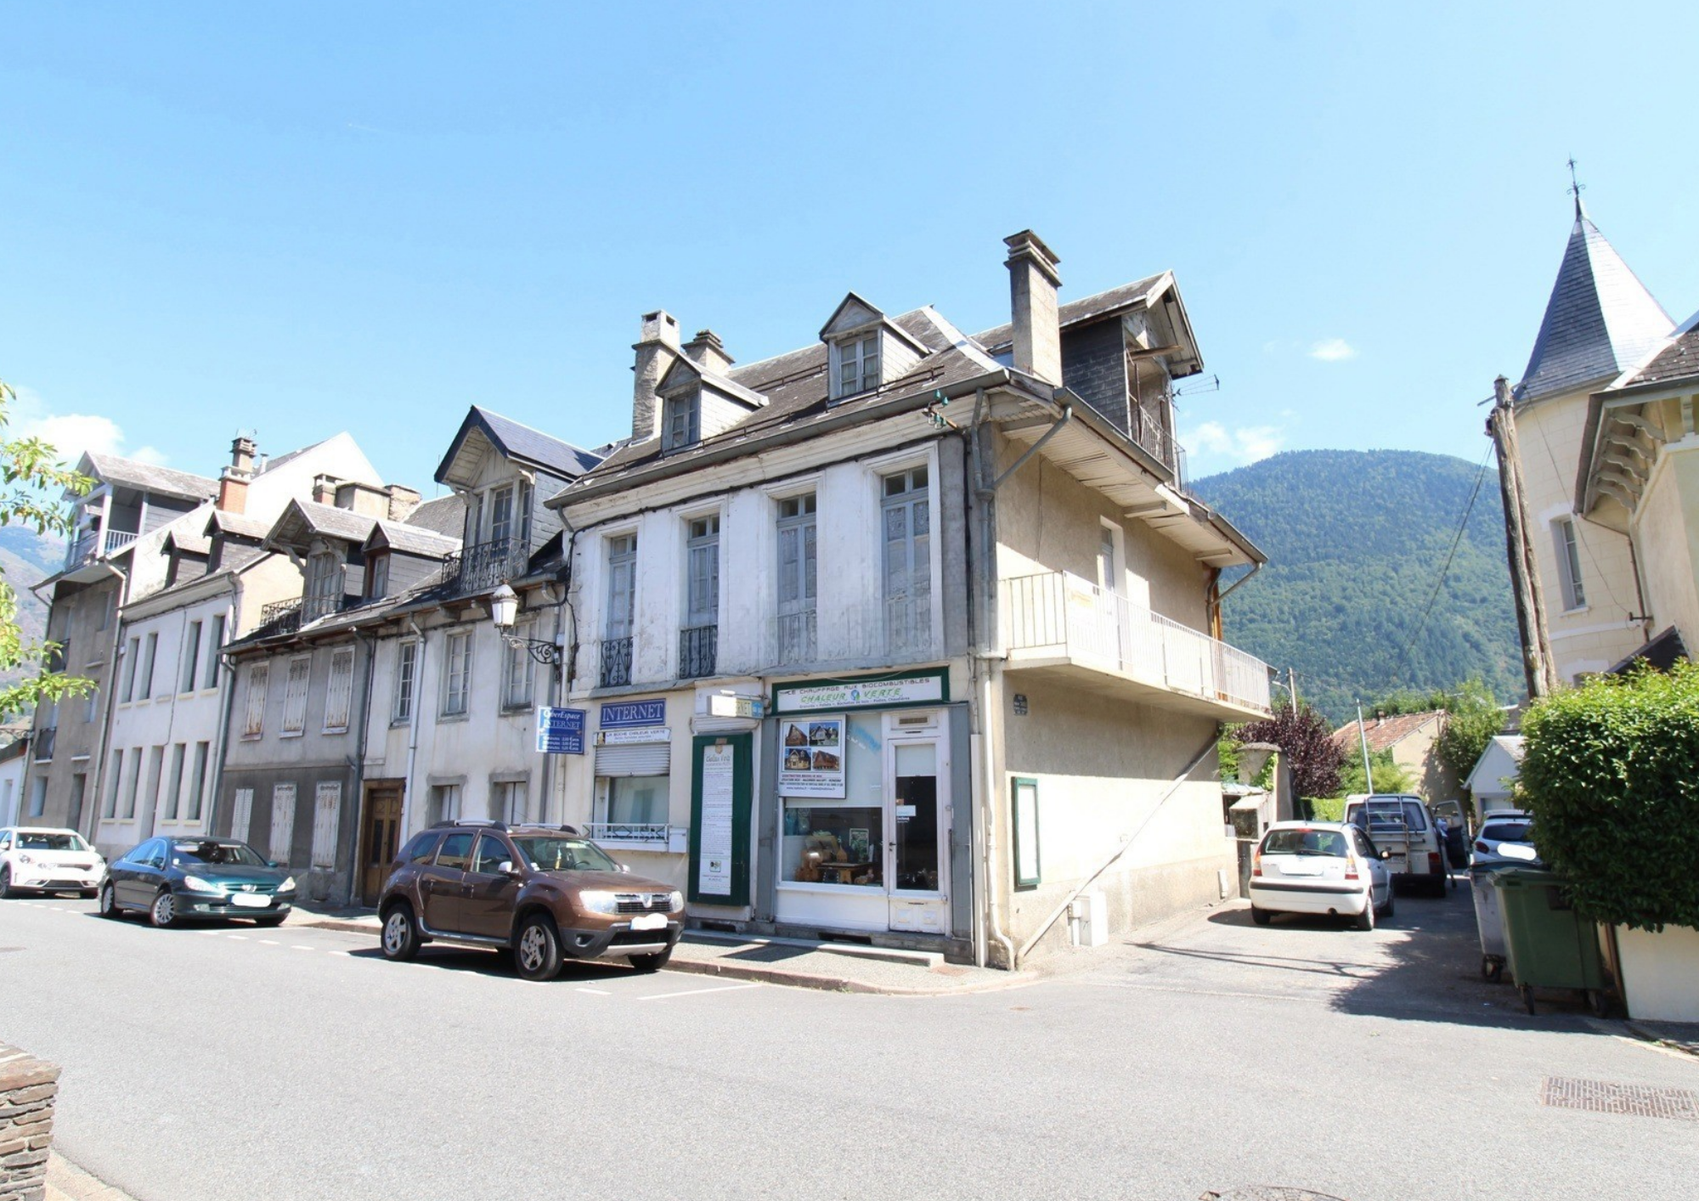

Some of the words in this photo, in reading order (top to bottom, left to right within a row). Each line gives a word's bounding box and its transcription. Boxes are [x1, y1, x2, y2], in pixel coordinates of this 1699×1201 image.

[799, 685, 840, 695] CHAUFFAGE
[861, 678, 930, 689] BIOCOMBUSTIBLES
[801, 691, 846, 703] CHALEUR
[863, 687, 902, 699] VERTE
[602, 703, 663, 721] INTERNET
[543, 720, 581, 728] INTERNET
